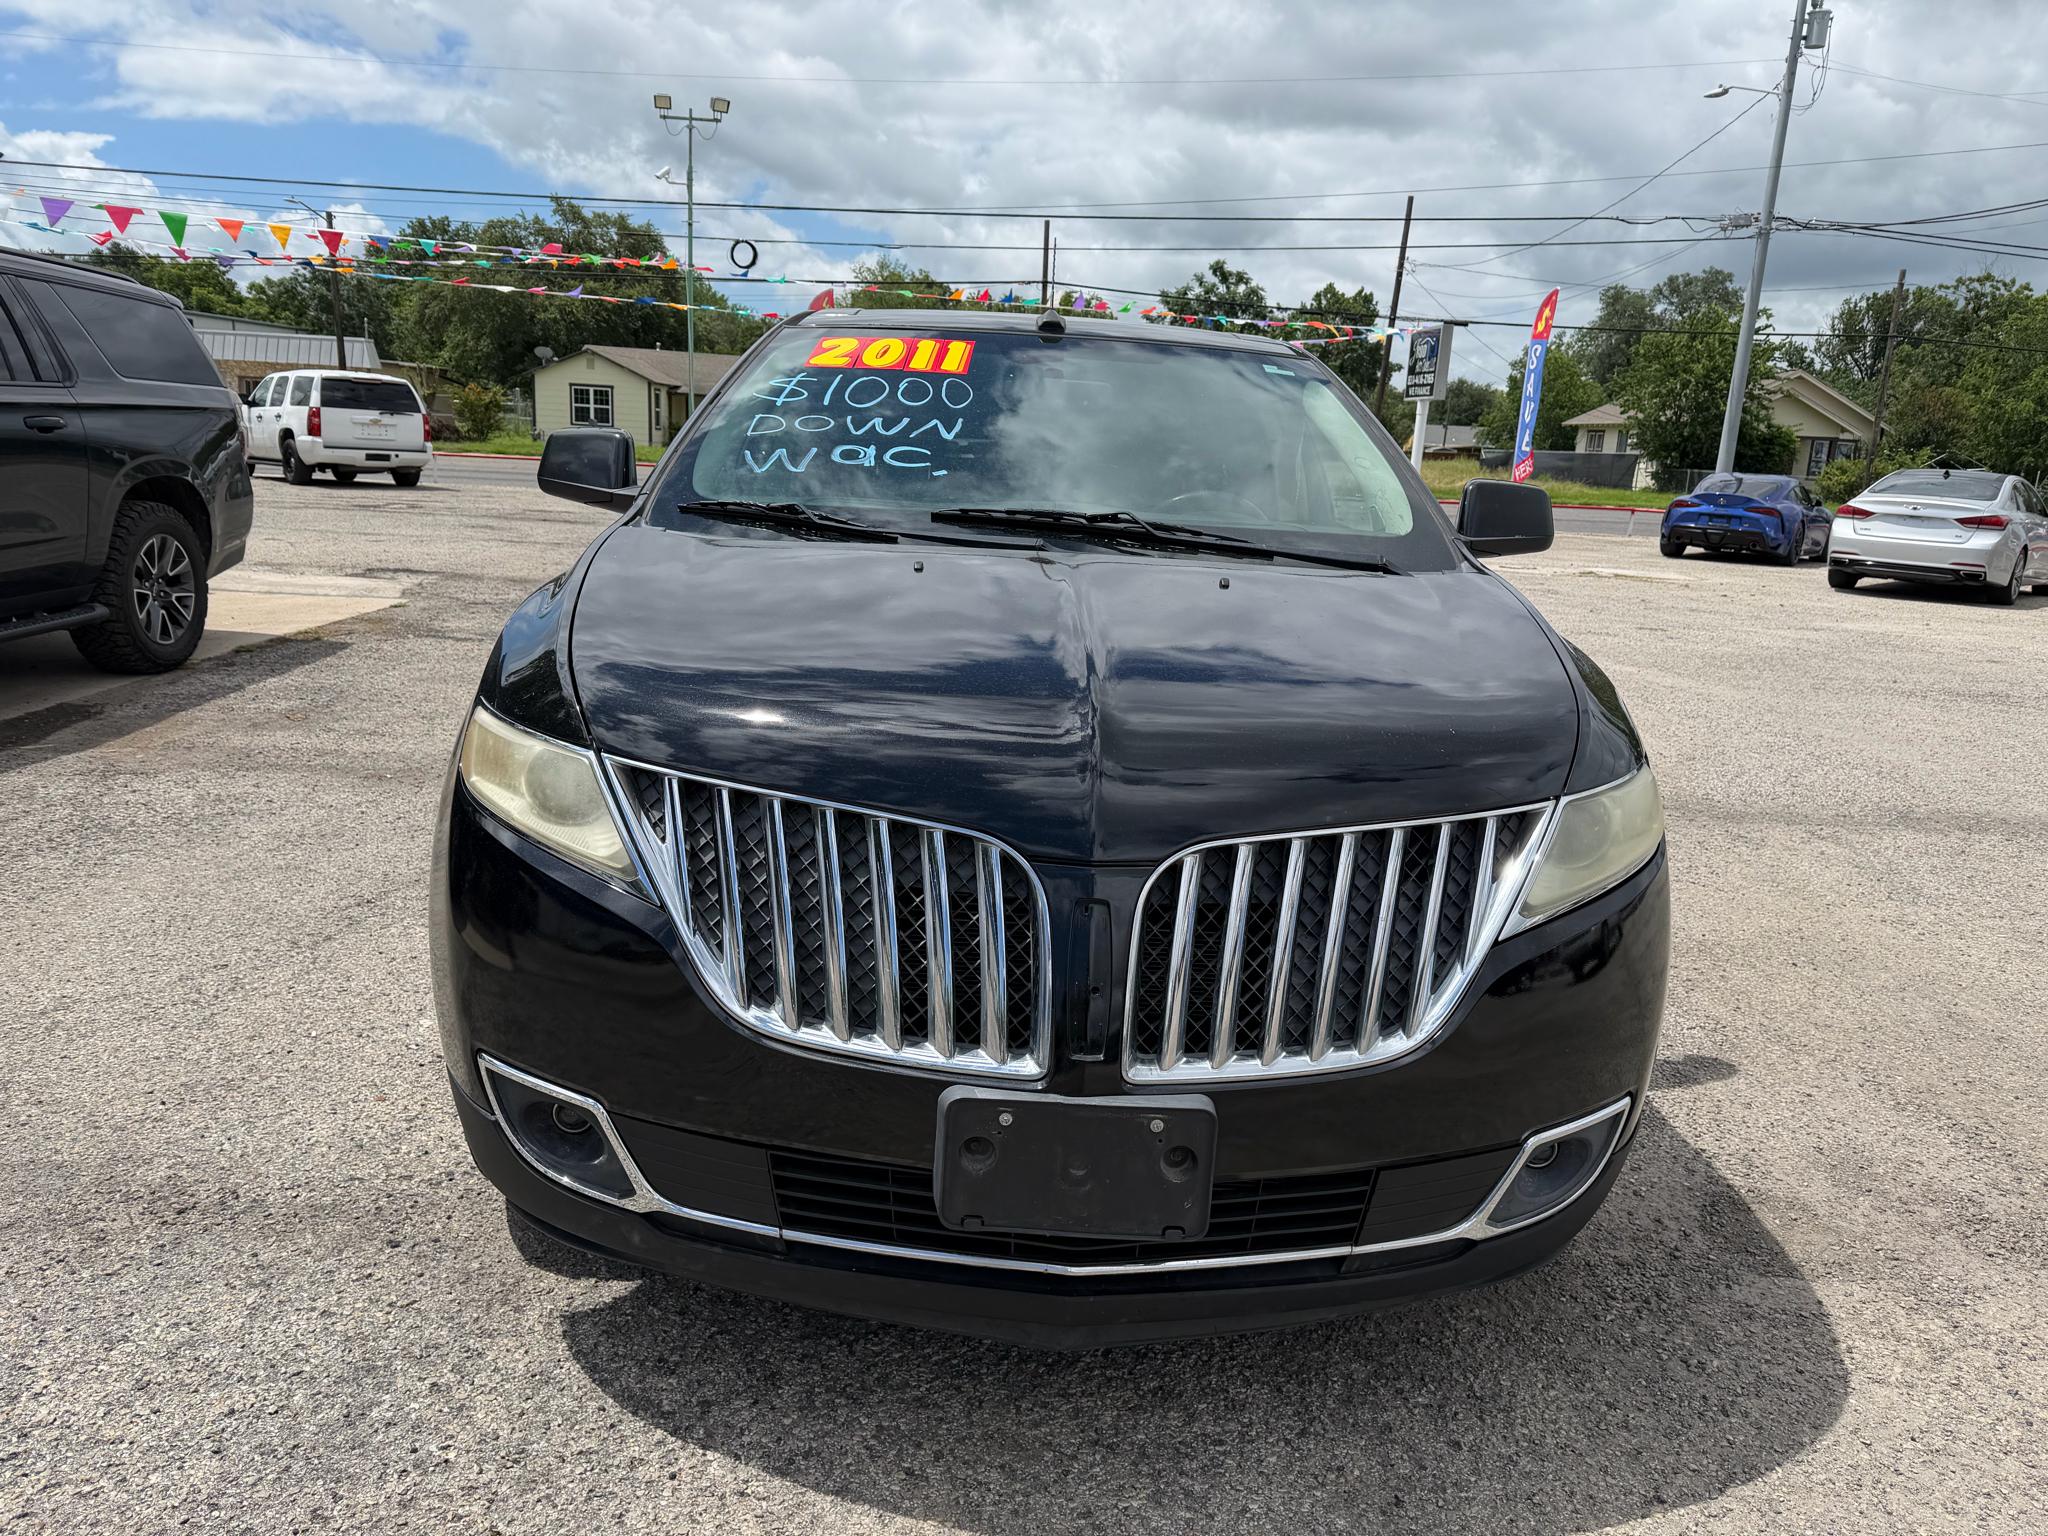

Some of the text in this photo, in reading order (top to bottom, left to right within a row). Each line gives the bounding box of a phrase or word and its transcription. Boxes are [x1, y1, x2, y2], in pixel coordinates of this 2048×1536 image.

[809, 337, 971, 372] 2011
[753, 372, 973, 408] $1000
[1521, 344, 1542, 451] SAVE
[747, 414, 964, 440] DOWN
